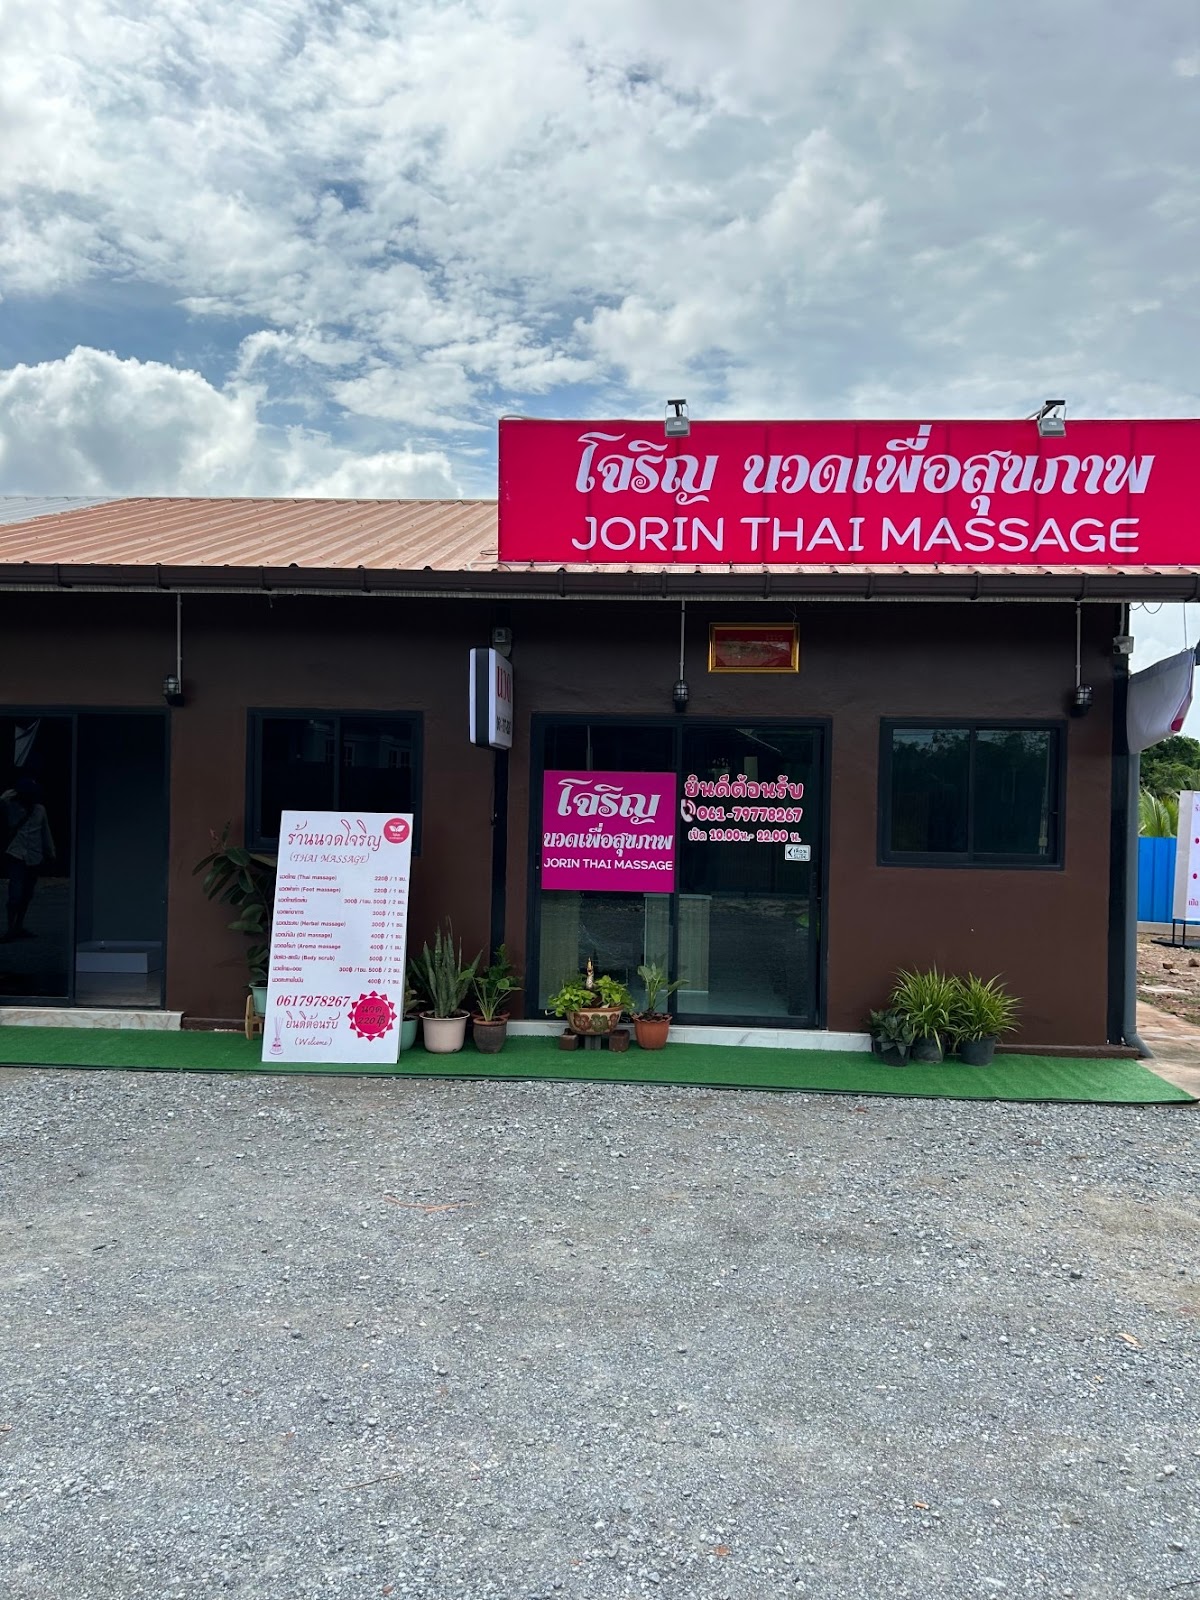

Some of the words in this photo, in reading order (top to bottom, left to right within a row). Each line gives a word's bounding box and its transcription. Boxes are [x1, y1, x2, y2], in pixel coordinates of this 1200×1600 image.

[573, 431, 719, 506] โจริญ
[743, 424, 1156, 518] นวดเพื่อสุขภาพ
[571, 516, 724, 552] JORIN
[740, 517, 865, 552] THAI
[881, 517, 1140, 553] MASSAGE
[684, 773, 804, 801] ยินดีต้อนรับ
[557, 777, 661, 825] โจริญ
[697, 805, 804, 823] 061-79778267
[543, 822, 674, 857] นวดเพื่อสุขภาพ
[687, 827, 708, 842] เปิด
[756, 830, 789, 843] 22.00
[289, 852, 319, 864] (THAI
[320, 853, 370, 866] MASSAGE)
[543, 857, 580, 868] JORIN
[582, 858, 612, 869] THAI
[614, 859, 673, 871] MASSAGE
[276, 995, 351, 1008] 0617978267
[294, 1036, 333, 1047] (Welcome)
